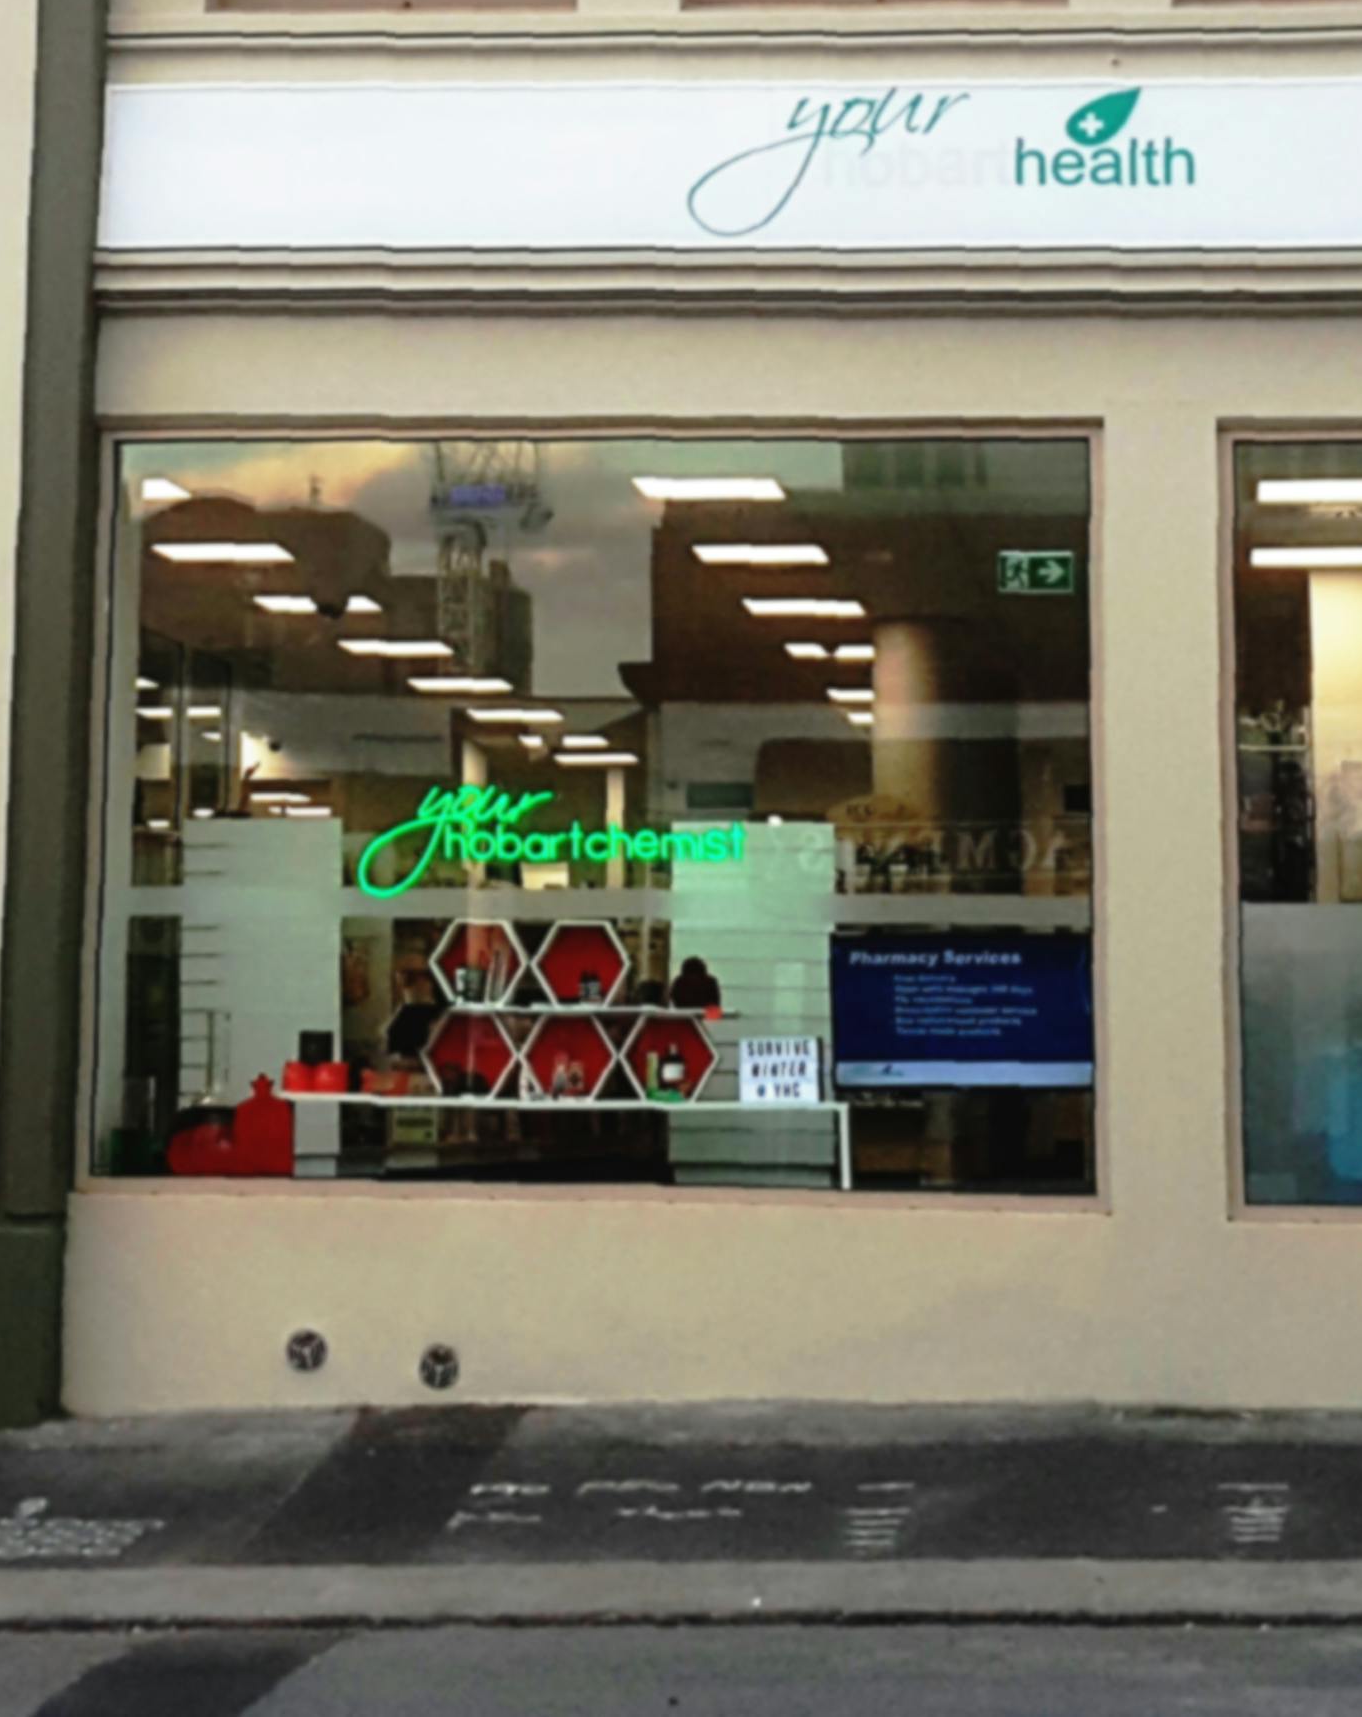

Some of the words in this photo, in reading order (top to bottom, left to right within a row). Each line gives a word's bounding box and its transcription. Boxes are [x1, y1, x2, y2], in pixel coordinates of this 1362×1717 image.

[687, 86, 971, 237] your
[357, 784, 554, 898] your
[444, 819, 747, 862] hobartchemist
[849, 950, 938, 968] Pharmacy
[943, 949, 1022, 966] Services
